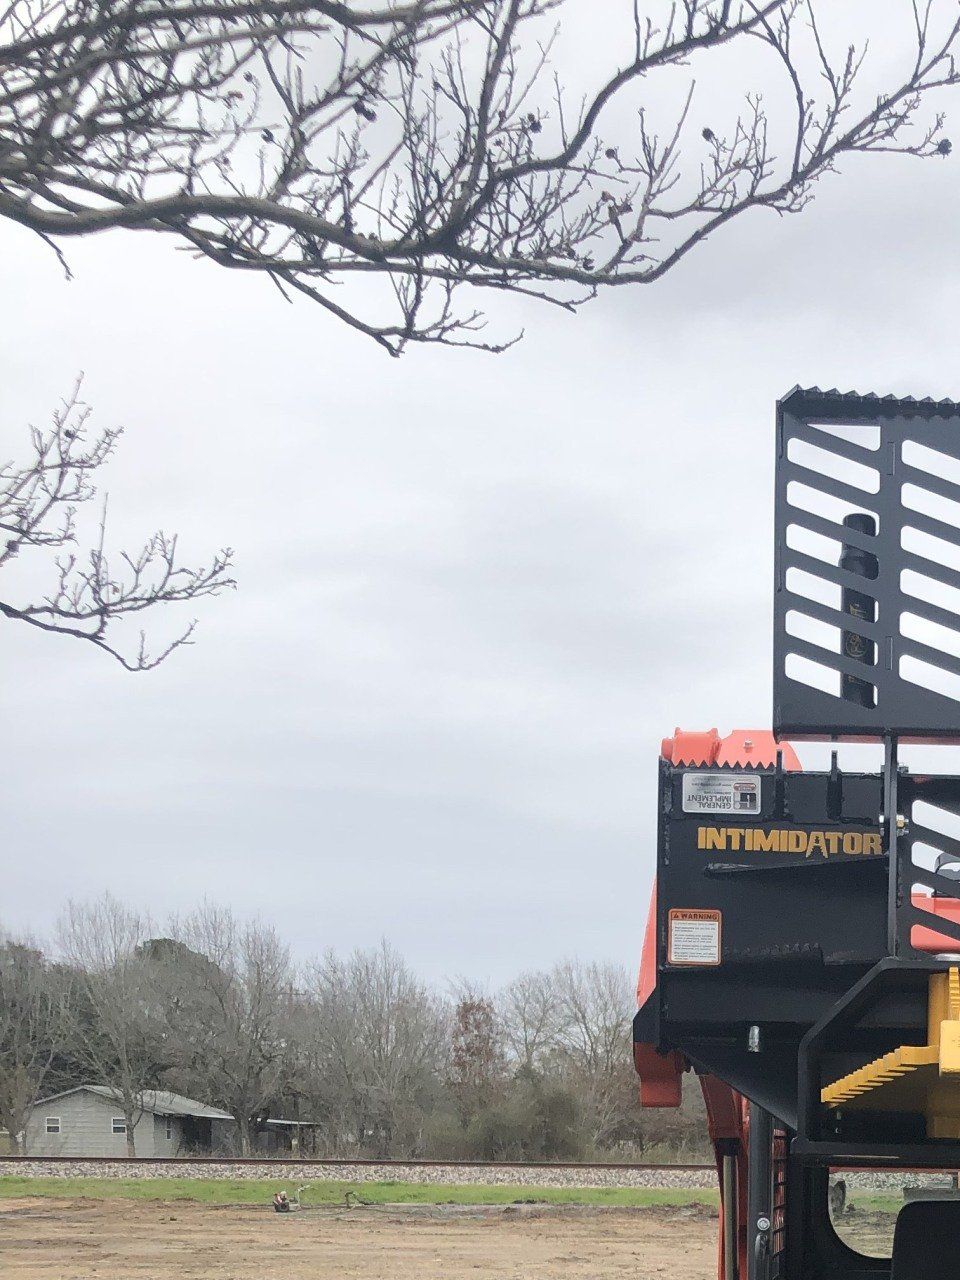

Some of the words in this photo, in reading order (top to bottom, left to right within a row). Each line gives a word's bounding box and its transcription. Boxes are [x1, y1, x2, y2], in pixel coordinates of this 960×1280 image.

[687, 794, 731, 802] IMPLEMENT
[697, 801, 731, 809] GENERAL
[698, 826, 882, 858] INTIMIDATOR
